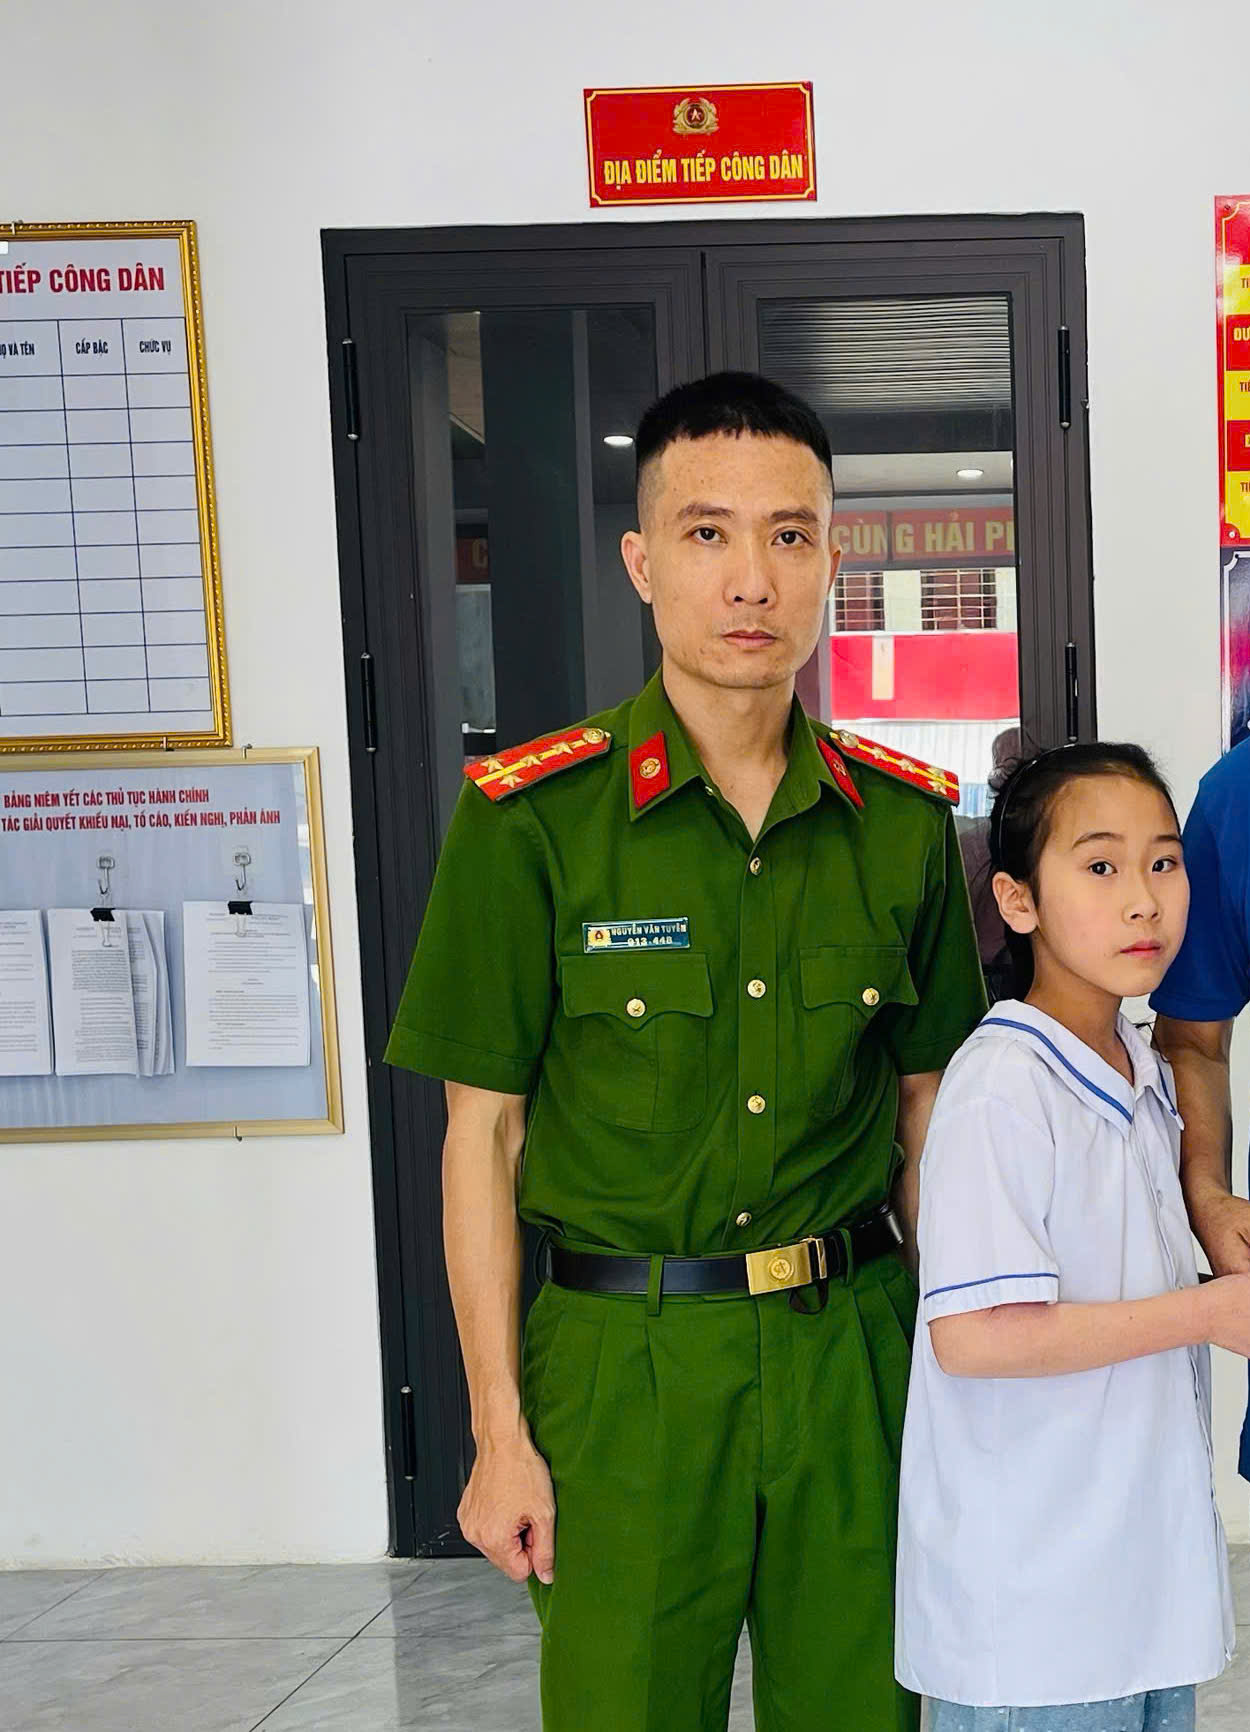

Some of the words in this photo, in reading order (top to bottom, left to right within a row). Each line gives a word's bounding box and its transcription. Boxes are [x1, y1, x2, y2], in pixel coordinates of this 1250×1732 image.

[604, 160, 632, 190] ĐỊA
[636, 149, 677, 183] ĐIỂM
[681, 149, 716, 182] TIẾP
[721, 151, 765, 181] CÔNG
[769, 149, 803, 179] DÂN
[49, 264, 111, 292] CÔNG
[118, 263, 164, 291] DÂN
[21, 341, 35, 355] TÊN
[76, 337, 90, 354] CẤP
[831, 519, 914, 554] CÙNG
[924, 512, 975, 553] HẢI
[4, 790, 31, 808] BẢNG
[34, 791, 60, 807] NIÊM
[63, 788, 80, 806] YẾT
[83, 789, 103, 806] CÁC
[106, 787, 124, 805] THỦ
[127, 791, 145, 807] TỤC
[149, 788, 176, 804] HÀNH
[179, 787, 209, 803] CHÍNH
[2, 815, 19, 831] TÁC
[23, 813, 43, 831] GIẢI
[46, 813, 76, 831] QUYẾT
[79, 811, 108, 829] KHIẾU
[111, 815, 131, 831] NẠI,
[134, 810, 146, 828] TỐ
[149, 811, 171, 828] CÁO,
[174, 809, 197, 826] KIẾN
[200, 812, 227, 828] NGHỊ,
[230, 807, 256, 825] PHẢN
